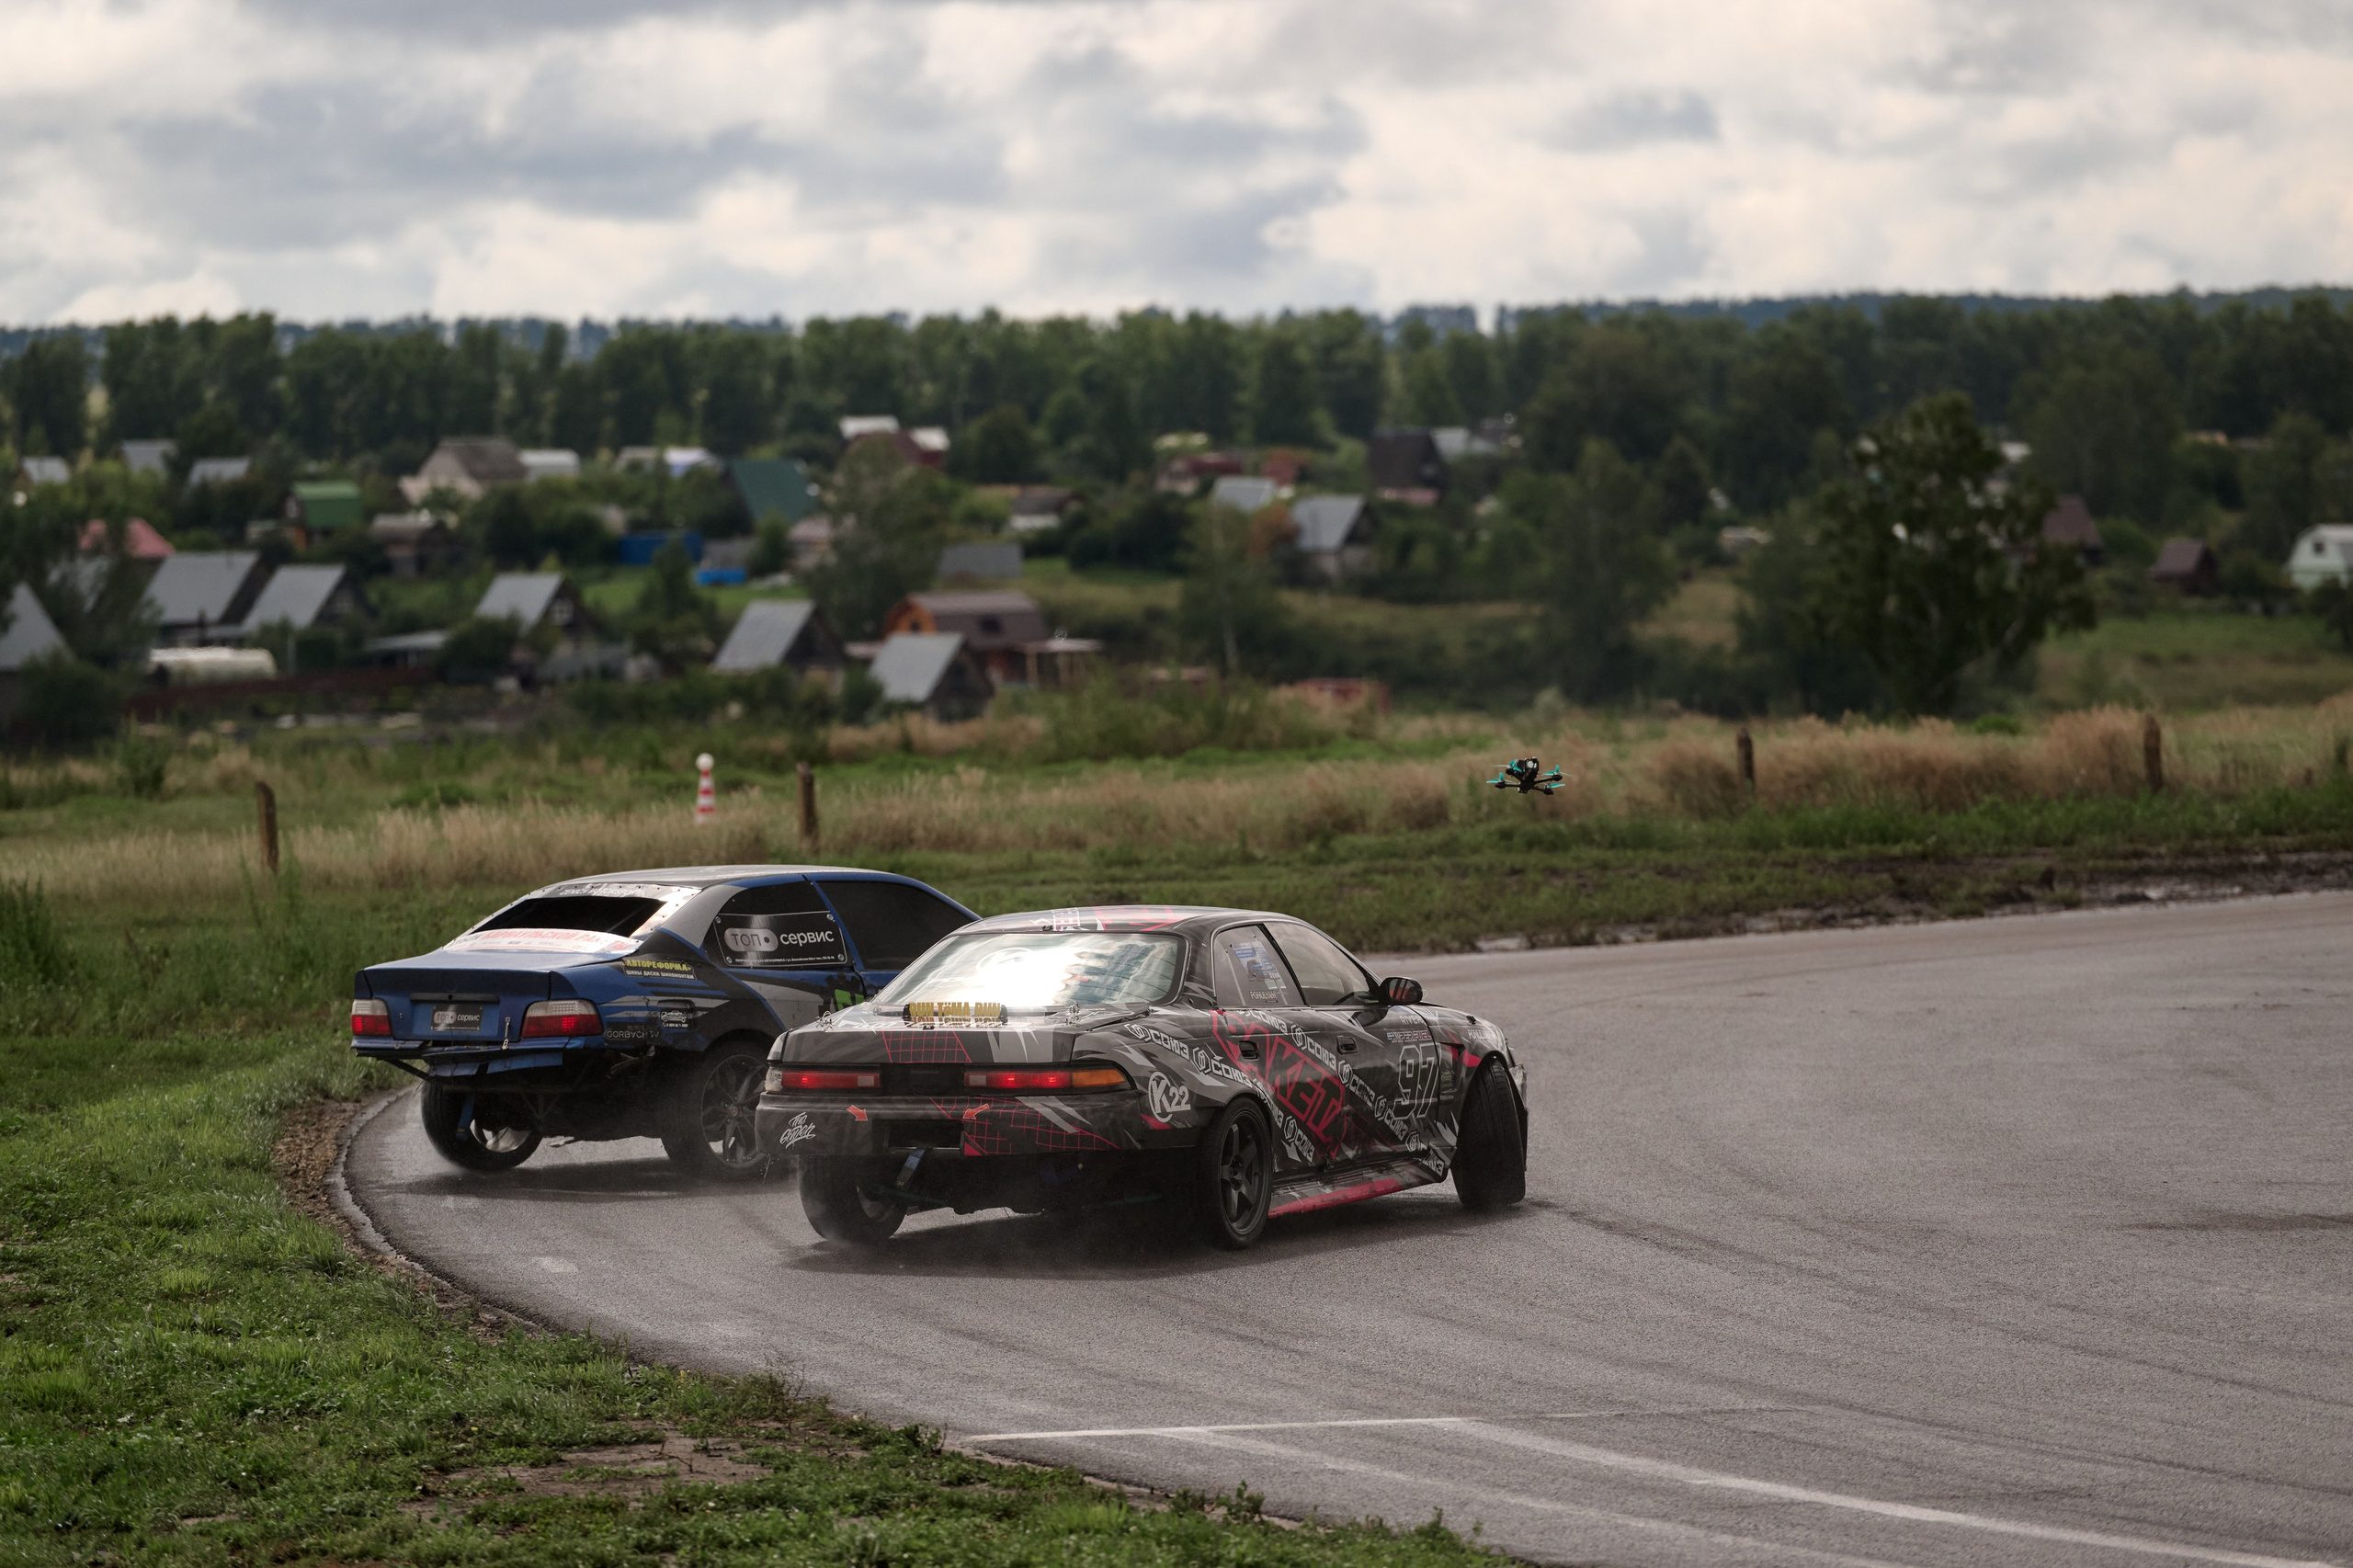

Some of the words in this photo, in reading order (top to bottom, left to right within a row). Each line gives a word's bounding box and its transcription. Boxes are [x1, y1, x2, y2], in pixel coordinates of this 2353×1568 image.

[731, 934, 761, 946] ТОП
[780, 930, 835, 947] сервис
[457, 1014, 480, 1022] сервис
[909, 1002, 935, 1017] RUN
[975, 1002, 1000, 1017] RUN
[1150, 1029, 1189, 1060] СОЮЗ
[1305, 1036, 1337, 1072] СОЮЗ
[1211, 1058, 1253, 1087] СОЮЗ
[1392, 1042, 1441, 1119] 97
